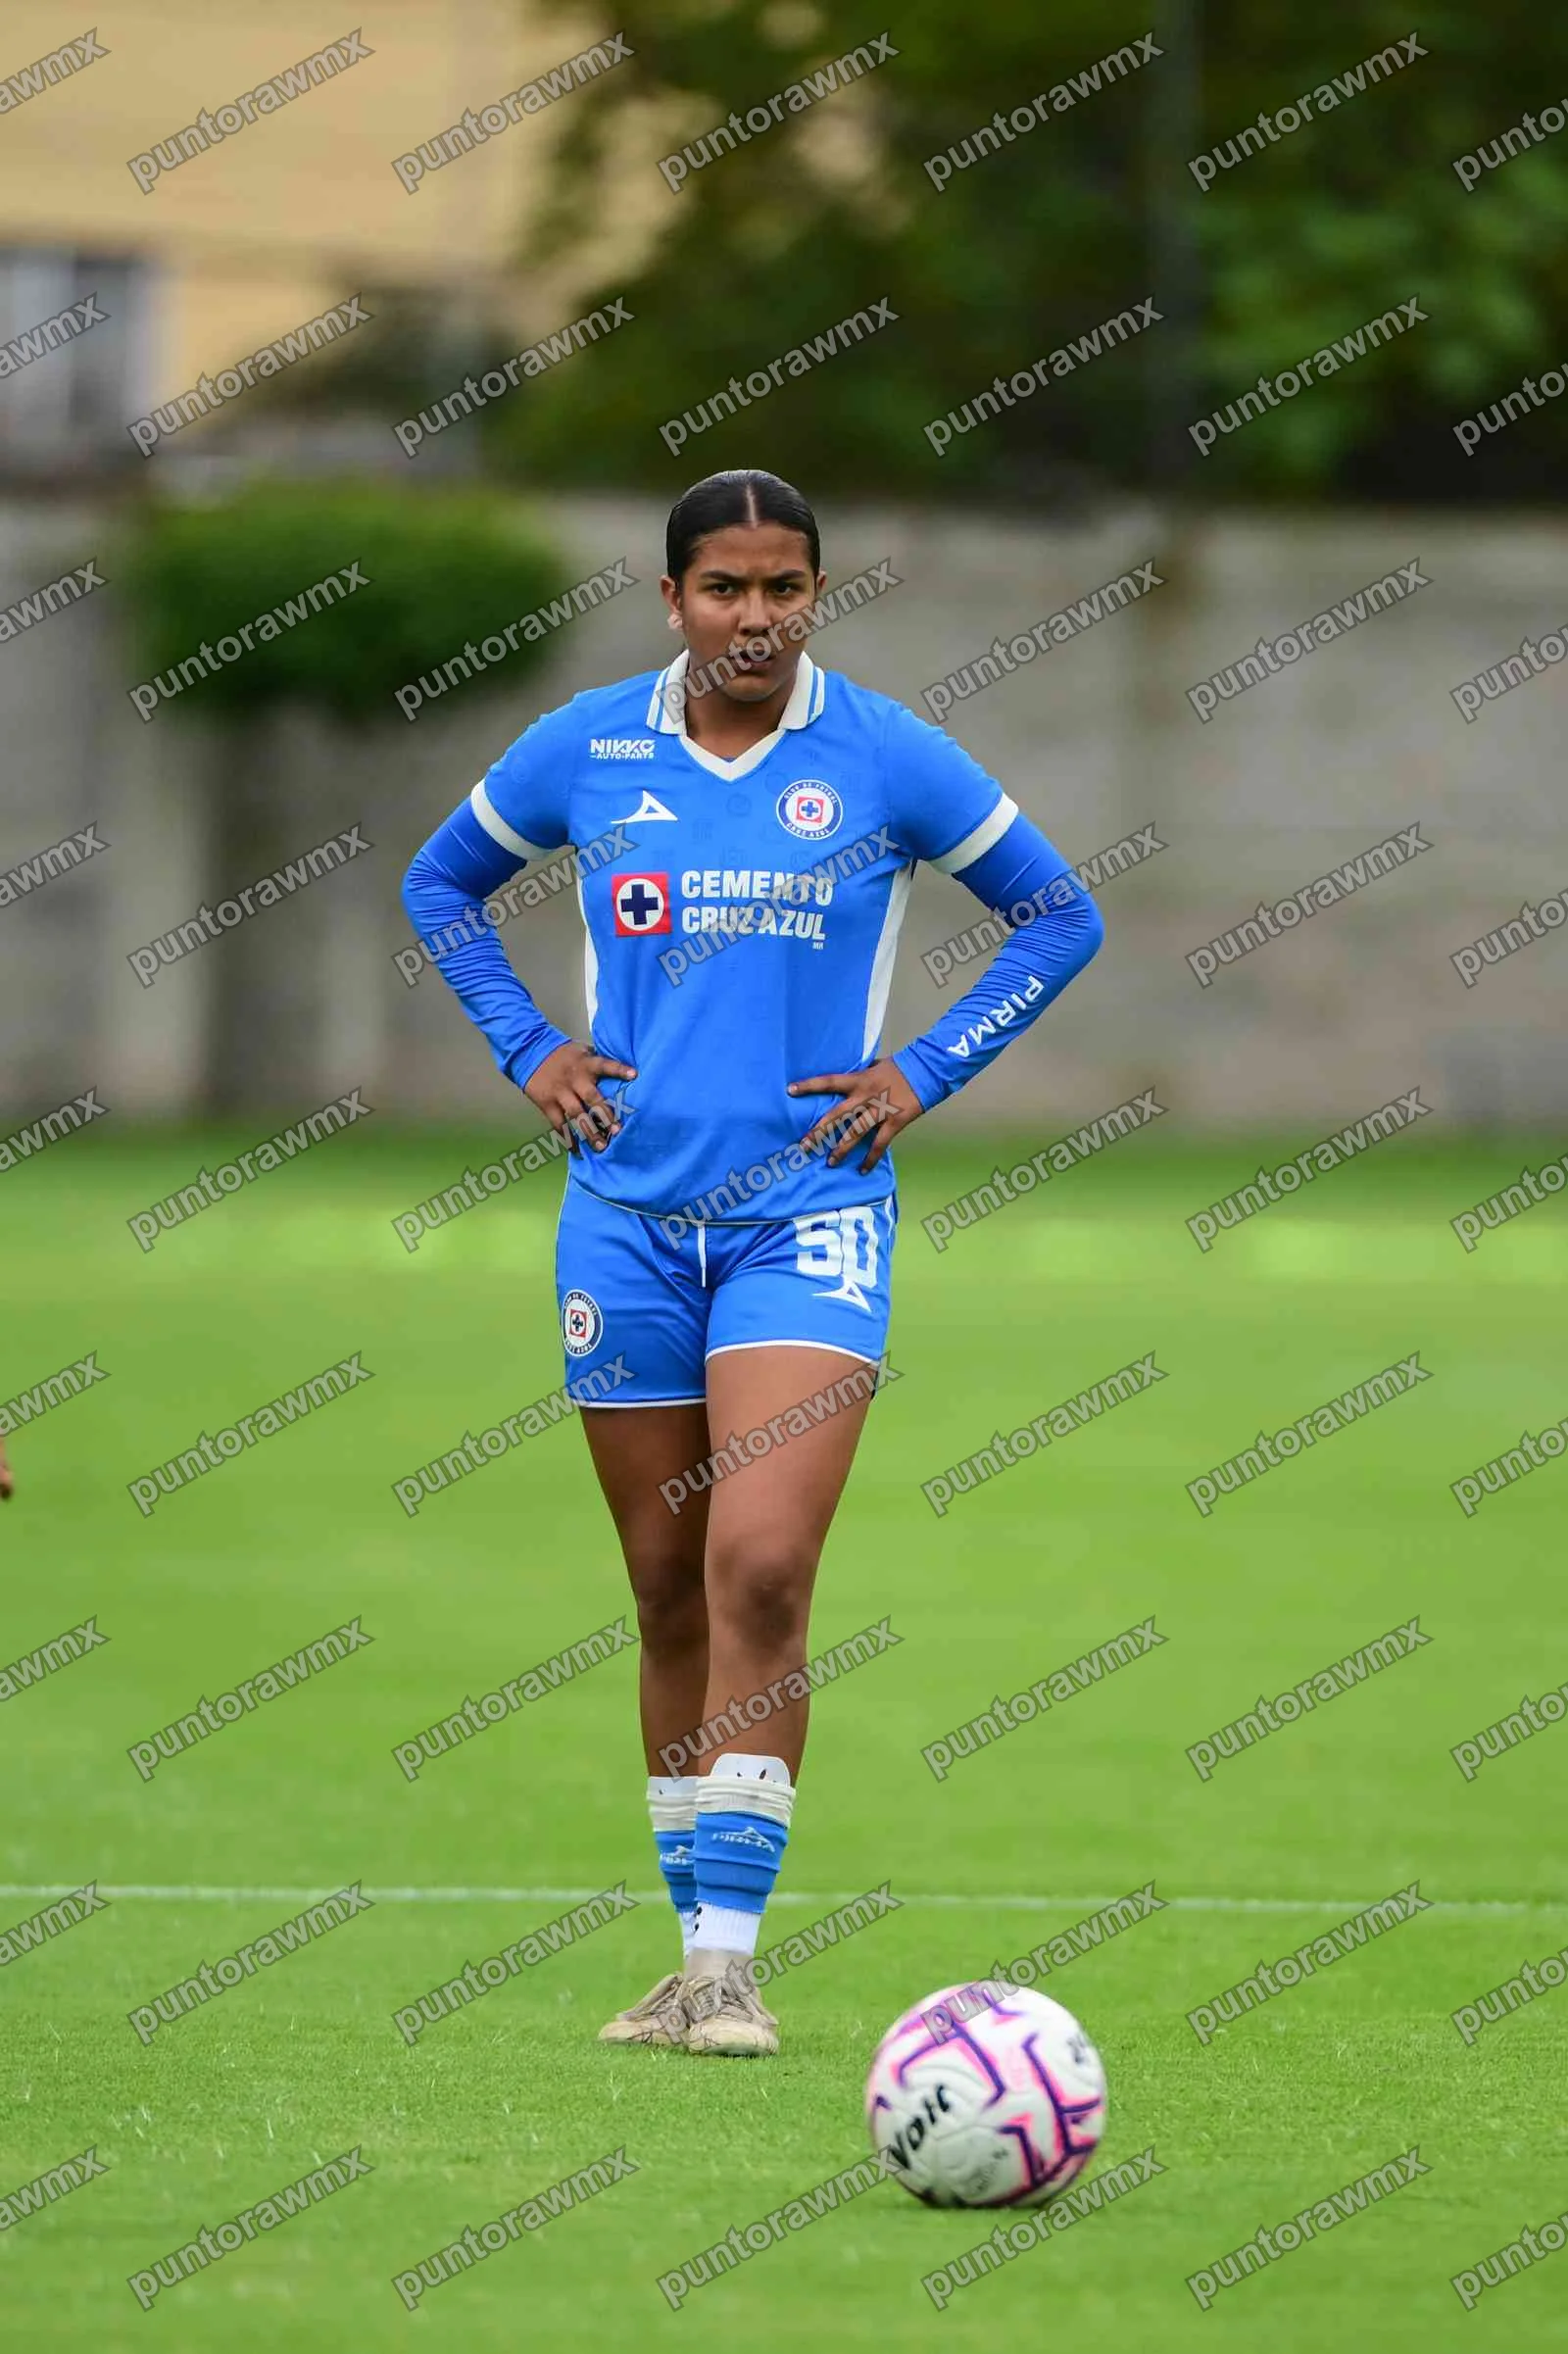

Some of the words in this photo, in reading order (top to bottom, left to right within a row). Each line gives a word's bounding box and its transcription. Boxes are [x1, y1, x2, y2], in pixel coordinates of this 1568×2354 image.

[681, 869, 833, 907] CEMENTO
[681, 906, 755, 934] CRUZ
[758, 907, 826, 940] AZUL
[946, 975, 1045, 1057] PIRMA
[792, 1205, 880, 1290] 50
